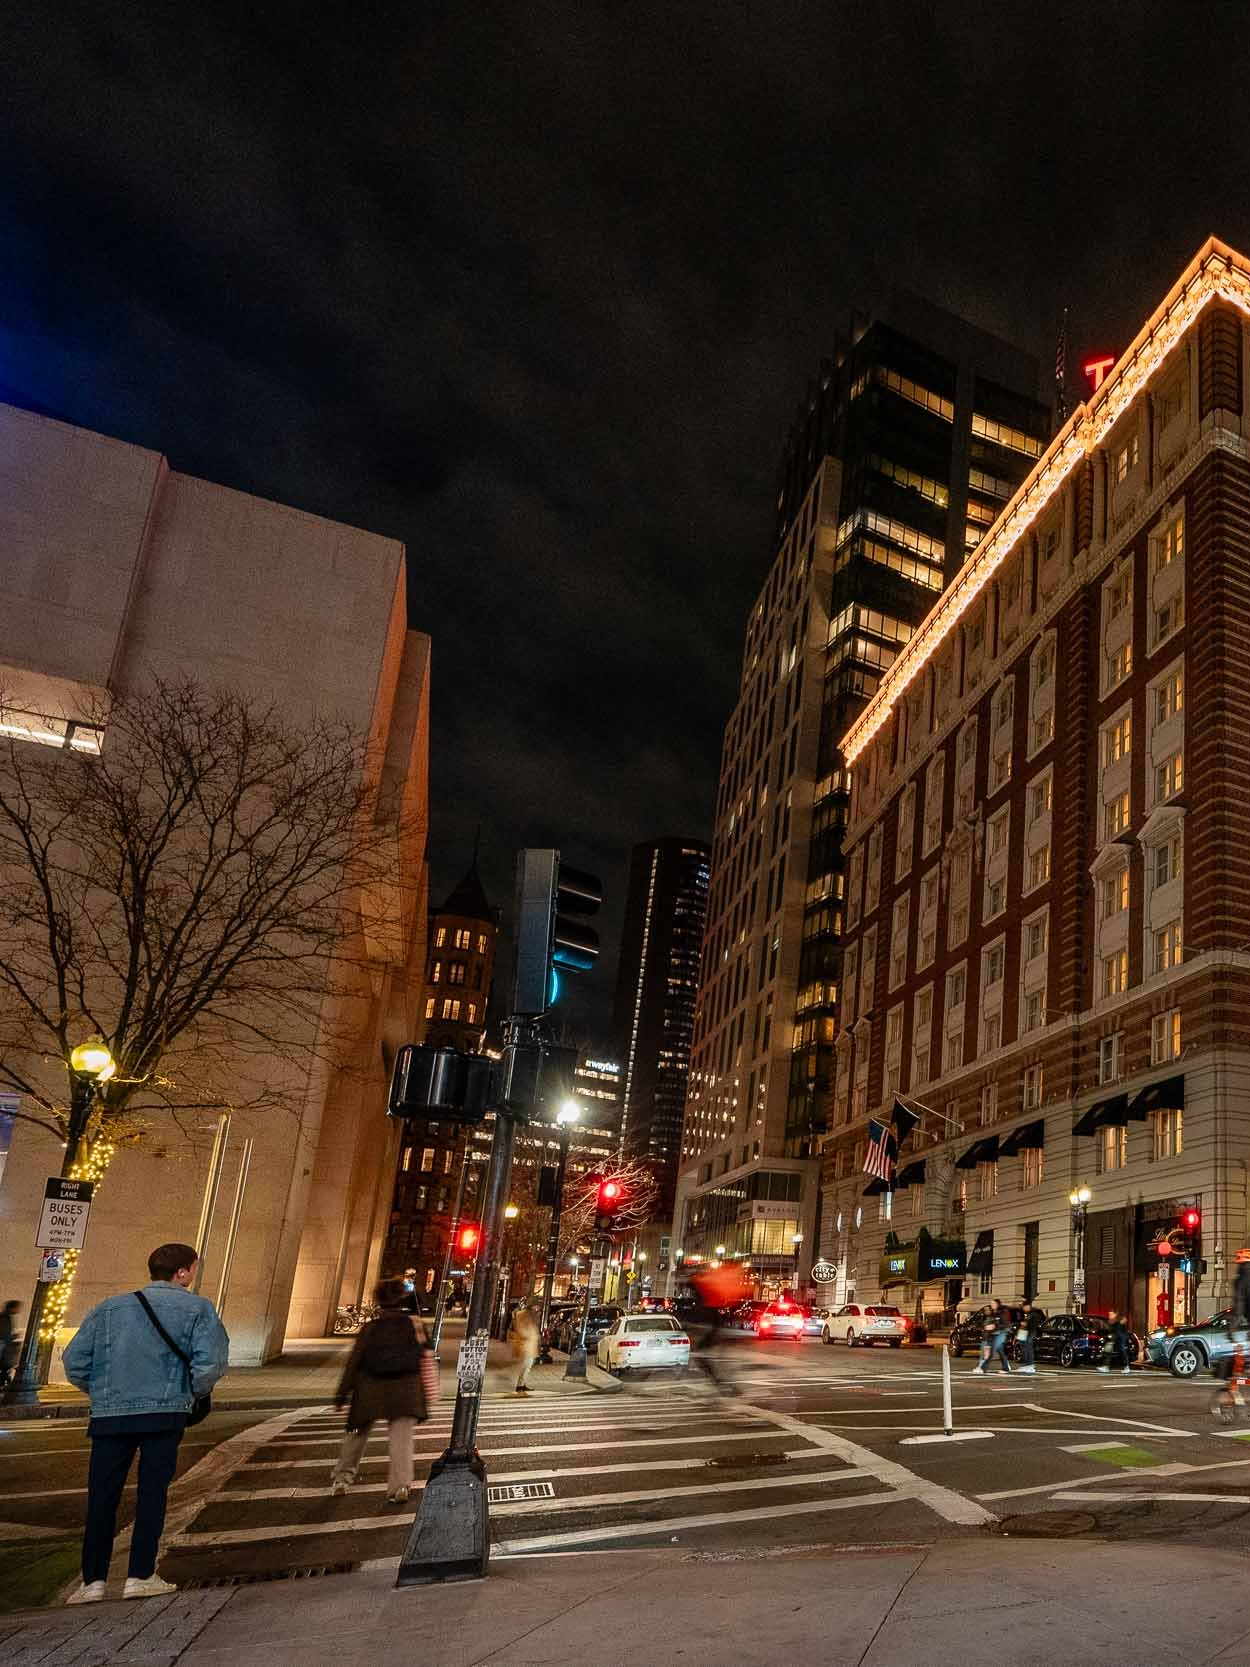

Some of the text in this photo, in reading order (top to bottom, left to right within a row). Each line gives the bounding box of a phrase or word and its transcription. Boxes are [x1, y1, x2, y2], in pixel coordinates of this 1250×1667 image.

[61, 1182, 80, 1190] RIGHT
[60, 1190, 78, 1199] LANE
[49, 1202, 83, 1215] BUSES
[50, 1216, 78, 1227] ONLY
[930, 1259, 959, 1268] LENOX
[815, 1266, 830, 1274] city
[815, 1271, 835, 1279] table
